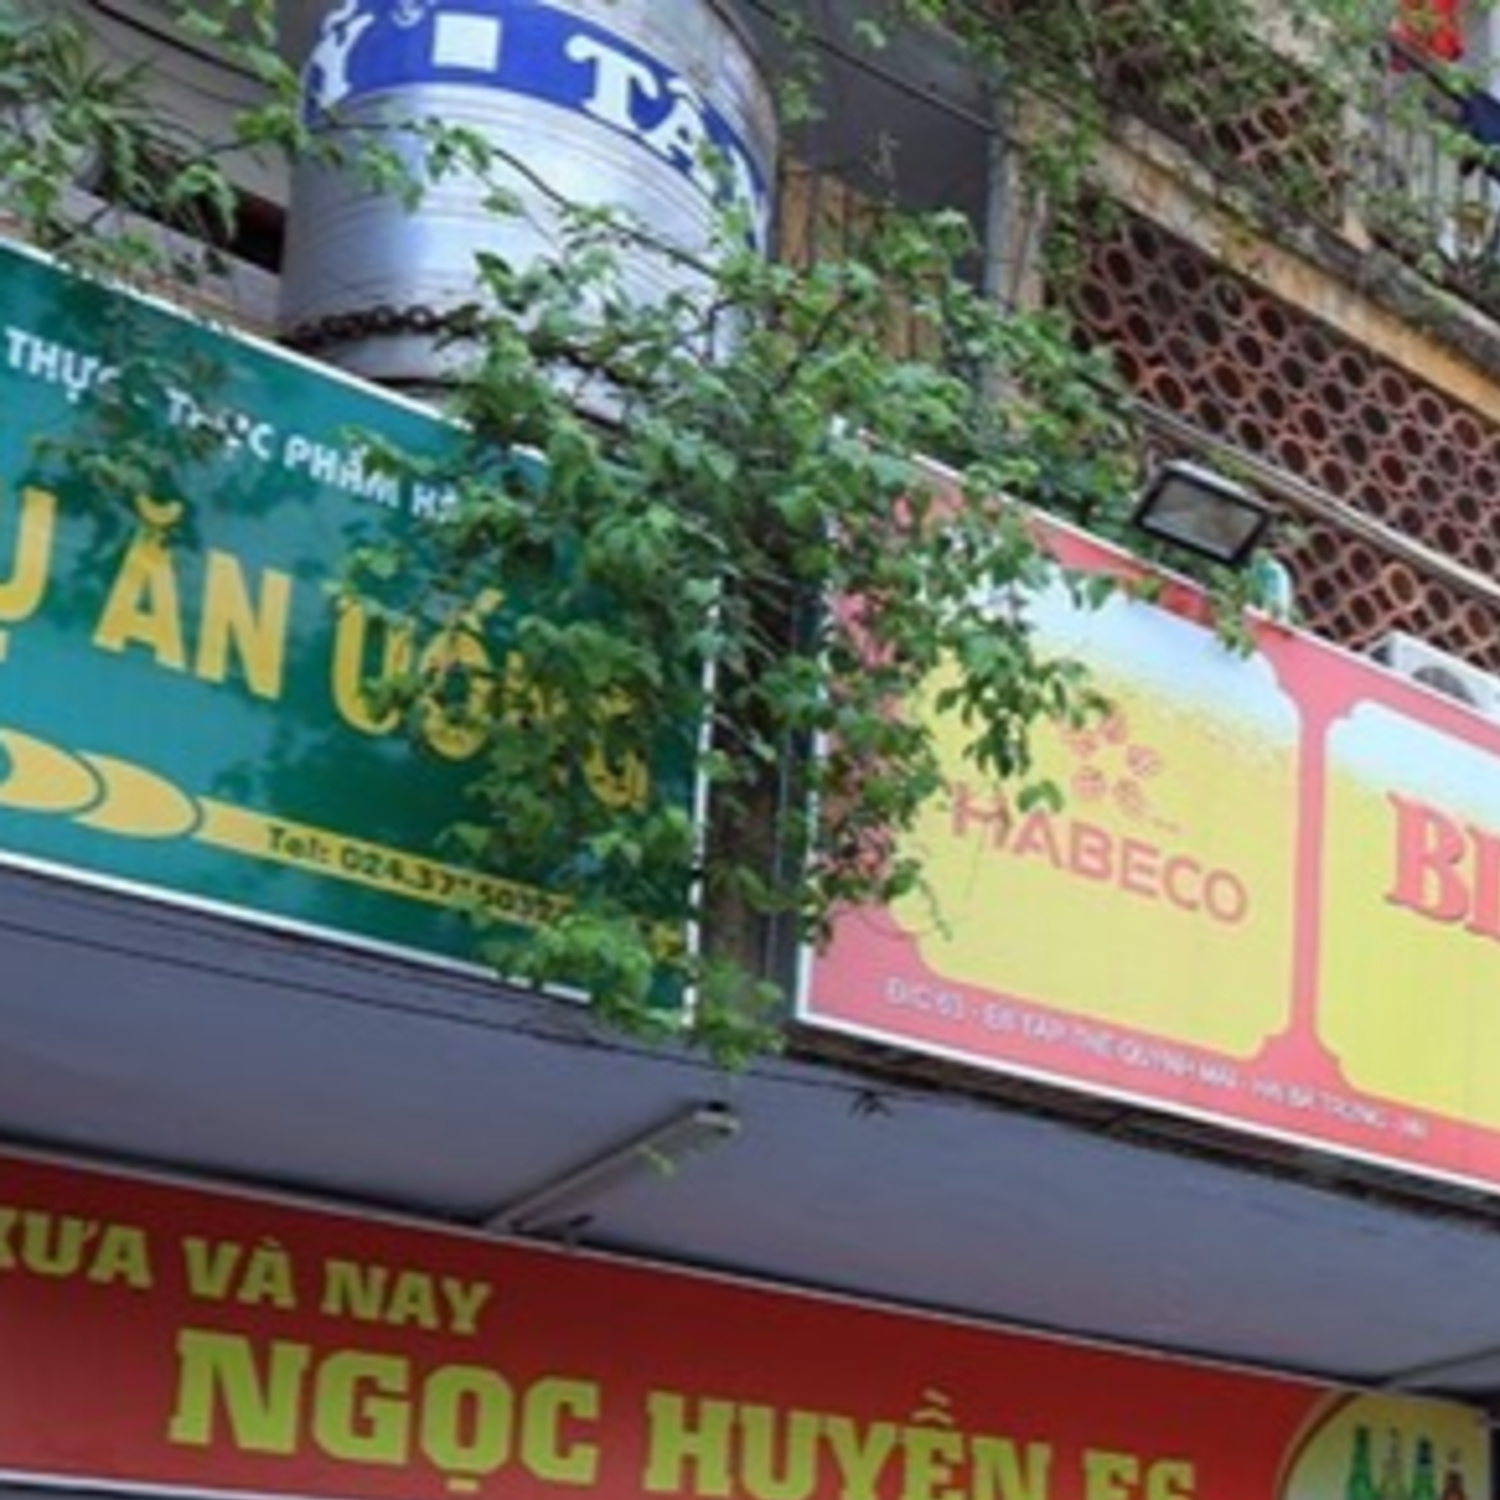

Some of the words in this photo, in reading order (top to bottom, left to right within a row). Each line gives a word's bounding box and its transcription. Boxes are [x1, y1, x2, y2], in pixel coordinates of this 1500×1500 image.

[93, 494, 291, 700] ĂN
[268, 827, 330, 866] Tel:
[952, 781, 1248, 924] HABECO
[0, 1208, 152, 1289] ƯA
[186, 1236, 296, 1310] VÀ
[320, 1259, 492, 1334] NAY
[167, 1328, 600, 1492] NGỌC
